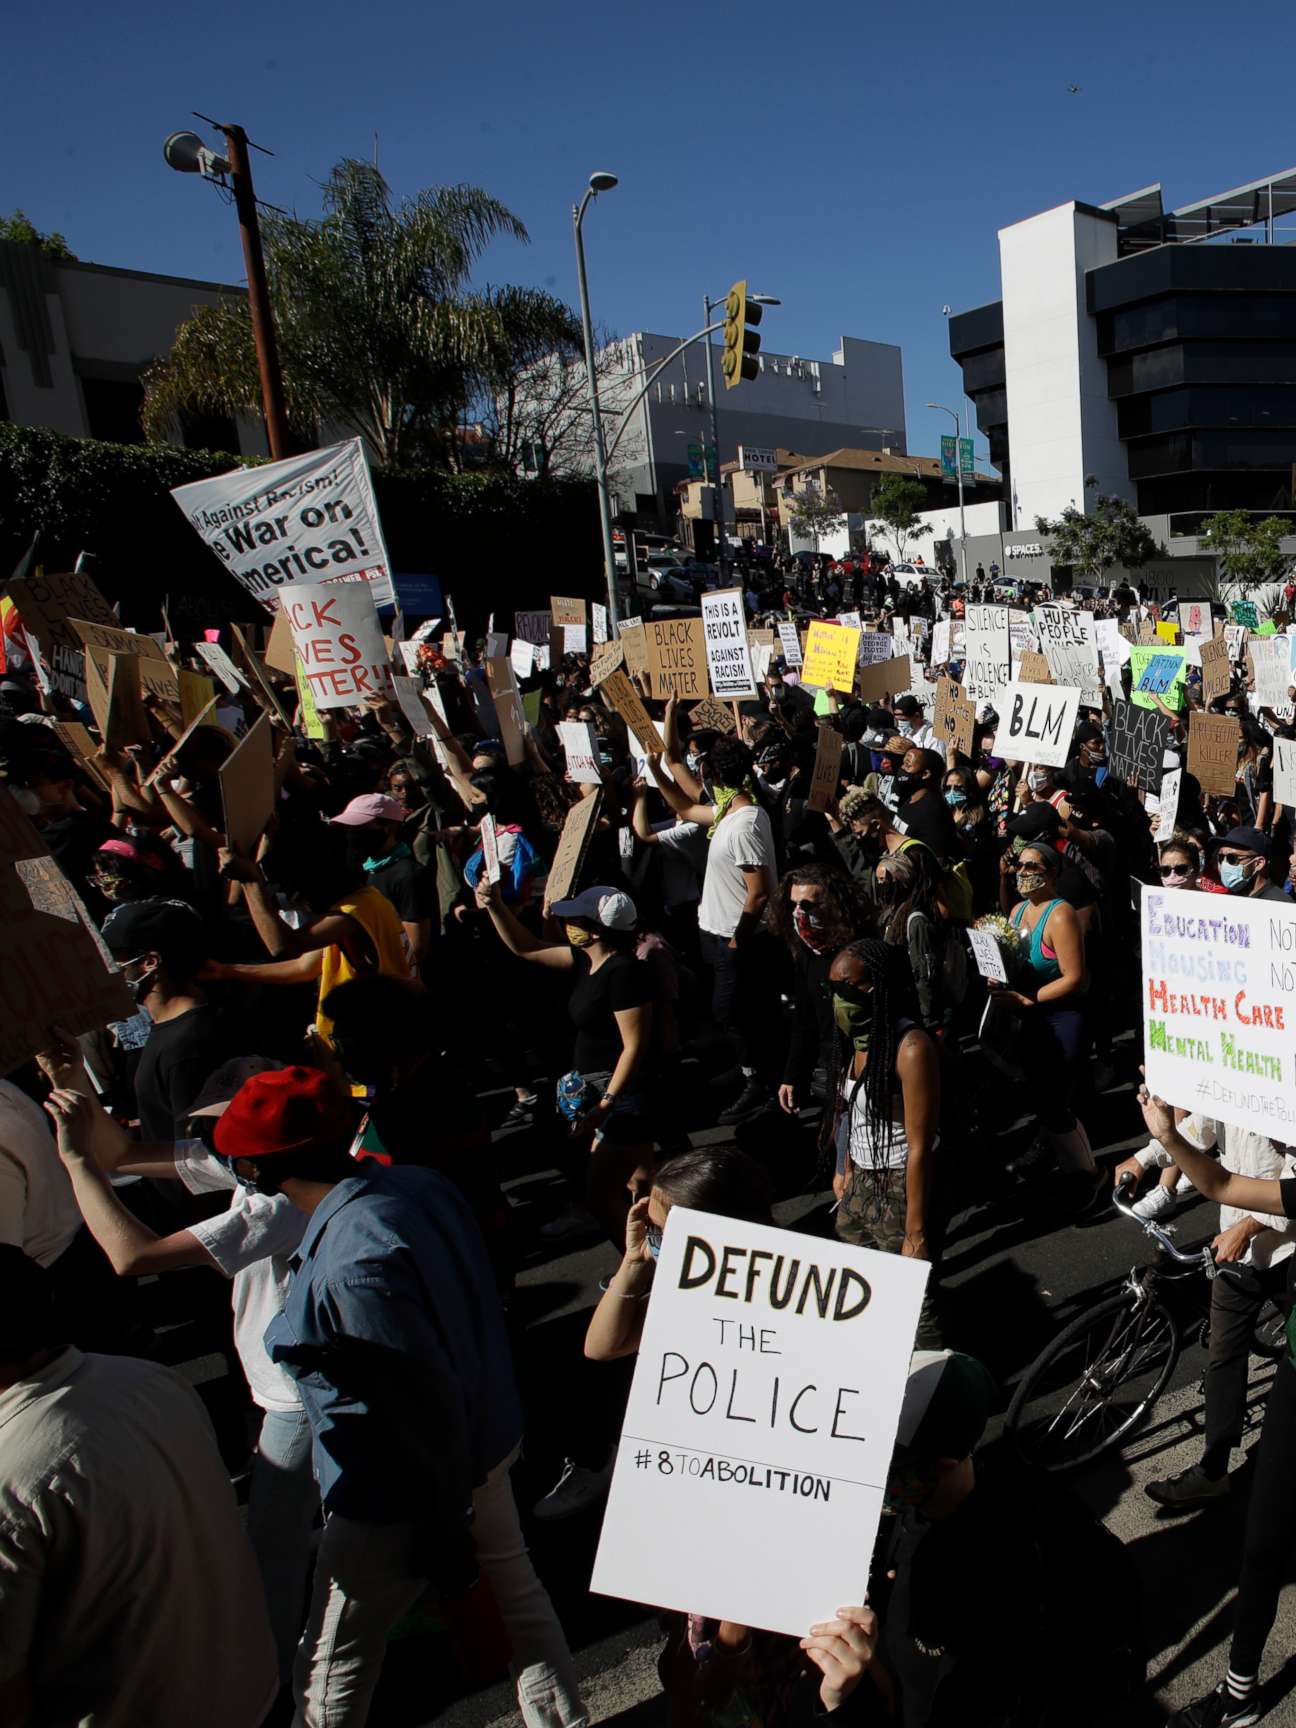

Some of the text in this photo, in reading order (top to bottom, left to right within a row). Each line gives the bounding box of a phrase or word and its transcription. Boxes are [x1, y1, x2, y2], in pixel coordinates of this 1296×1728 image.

[744, 453, 776, 465] HOTEL
[201, 496, 262, 530] Against
[224, 514, 290, 556] War
[300, 498, 354, 529] on
[704, 603, 739, 620] THIS IS A
[968, 608, 1006, 632] SILENCE
[1043, 609, 1081, 627] HURT
[654, 622, 695, 647] BLACK
[706, 620, 741, 640] REVOLT
[1038, 621, 1089, 641] PEOPLE
[658, 647, 695, 670] LIVES
[711, 647, 745, 663] AGAINST
[980, 643, 992, 658] IS
[658, 671, 699, 695] MATTER
[715, 664, 746, 680] RACISM
[968, 662, 1009, 687] VIOLENCE
[968, 685, 996, 700] #BLM
[1140, 678, 1170, 694] BLM
[1009, 693, 1068, 746] BLM
[1113, 700, 1168, 748] BLACK
[1114, 729, 1160, 770] LIVES
[1148, 978, 1227, 1020] HEALTH
[1233, 990, 1286, 1031] CARE
[1148, 1018, 1215, 1063] MENTAL
[1219, 1031, 1283, 1083] HEALTH
[677, 1234, 873, 1322] DEFUND
[712, 1317, 783, 1355] THE
[656, 1351, 866, 1442] POLICE
[633, 1448, 832, 1503] #8TOABOLITION
